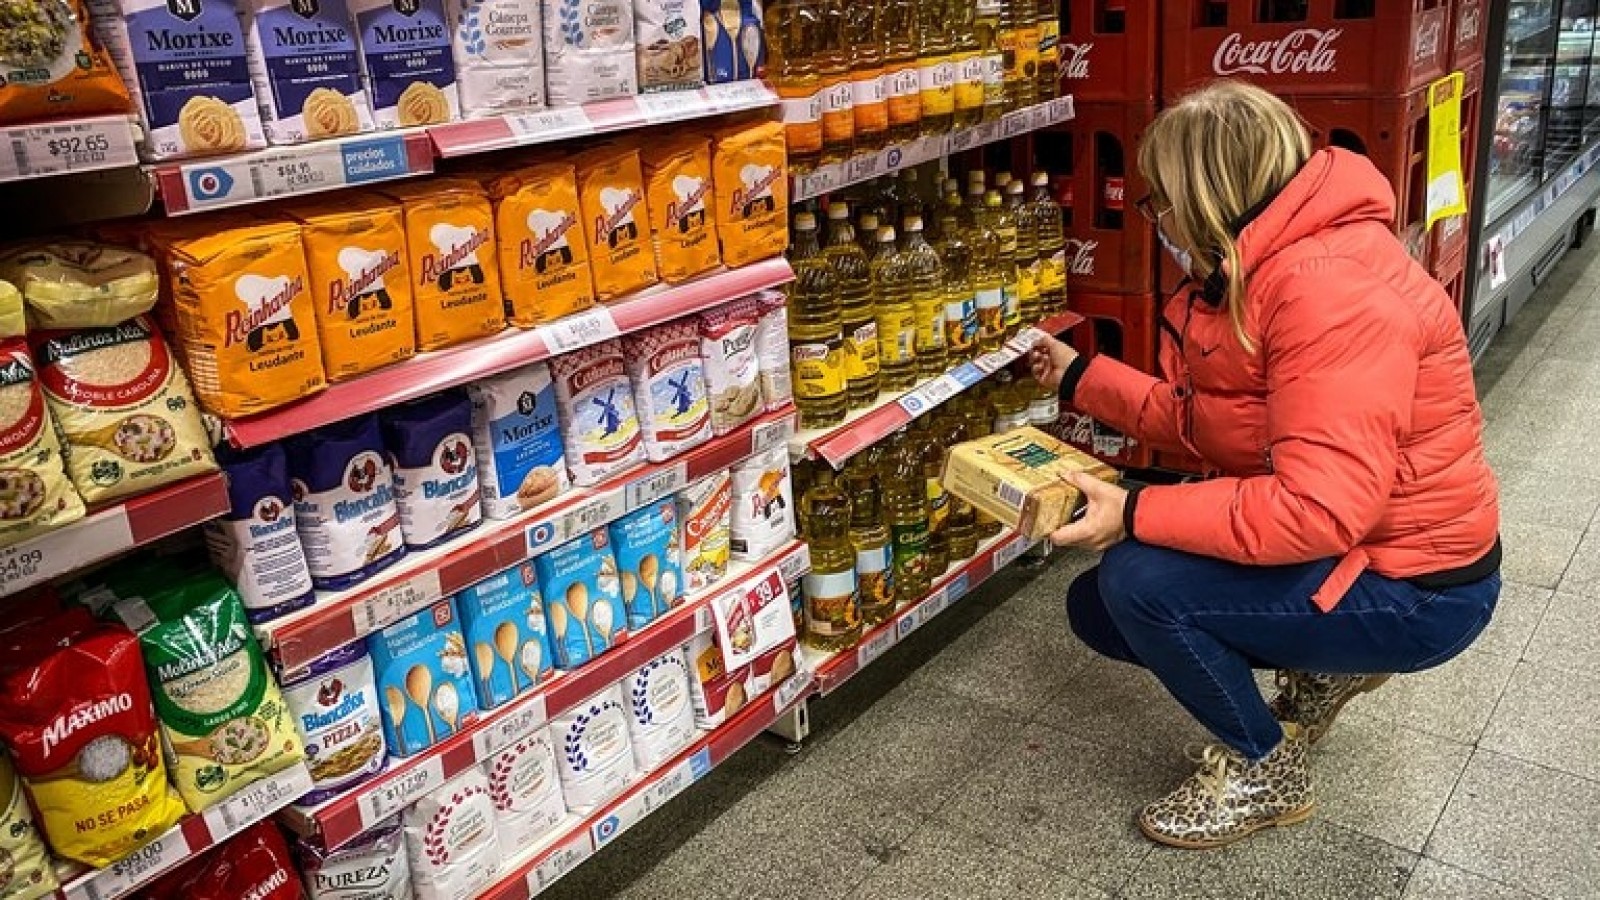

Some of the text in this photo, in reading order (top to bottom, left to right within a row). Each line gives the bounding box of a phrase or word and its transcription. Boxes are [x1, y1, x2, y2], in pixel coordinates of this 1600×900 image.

[146, 26, 234, 51] Morixe
[273, 23, 347, 47] Morixe
[374, 22, 443, 45] Morixe
[1213, 28, 1342, 75] Coca-Cola
[48, 137, 109, 155] $92.65
[346, 147, 384, 163] precios
[348, 158, 395, 175] cuidados
[420, 227, 490, 286] Reinharina
[327, 250, 400, 314] Reinharina
[537, 272, 576, 291] Leudante
[224, 274, 303, 348] Reinharina
[440, 292, 488, 311] Leudante
[350, 318, 397, 339] Leudante
[250, 350, 305, 372] Leudante
[502, 414, 553, 445] Morixe
[302, 690, 366, 733] Blancaflor
[42, 693, 133, 759] MAXIMO
[322, 722, 362, 750] PIZZA
[75, 795, 149, 834] NO SE PASA
[112, 840, 163, 876] $99.00
[314, 864, 390, 891] PUREZA
